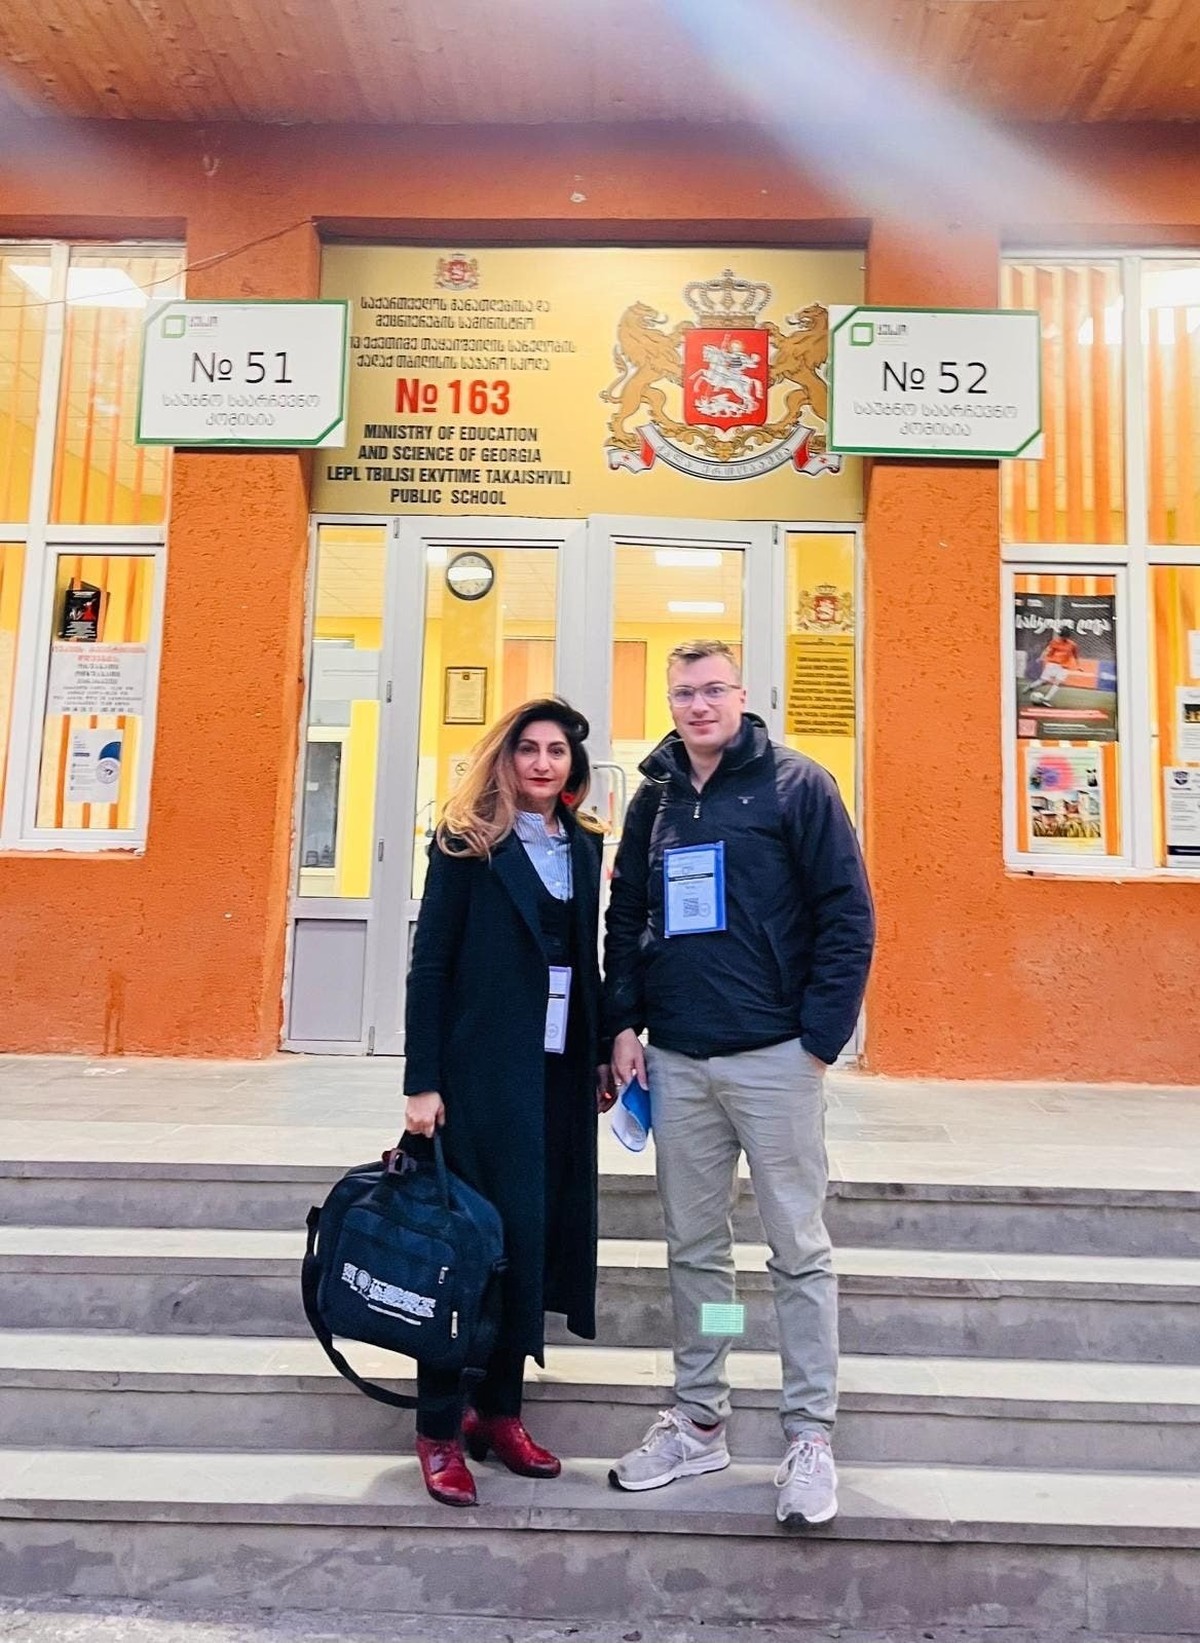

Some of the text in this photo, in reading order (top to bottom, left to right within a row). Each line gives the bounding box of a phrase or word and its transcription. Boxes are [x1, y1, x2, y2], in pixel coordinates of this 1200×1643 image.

[361, 297, 446, 310] საქართველოს
[536, 300, 550, 312] და
[245, 352, 293, 384] 51
[938, 362, 988, 394] 52
[448, 380, 511, 415] 163
[364, 424, 538, 442] MINISTRY OF EDUCATION
[358, 446, 542, 463] AND SCIENCE OF GEORGIA
[327, 466, 571, 485] LEPL TBILISI EKVTIME TAKAISHVILI
[390, 489, 506, 504] PUBLIC SCHOOL
